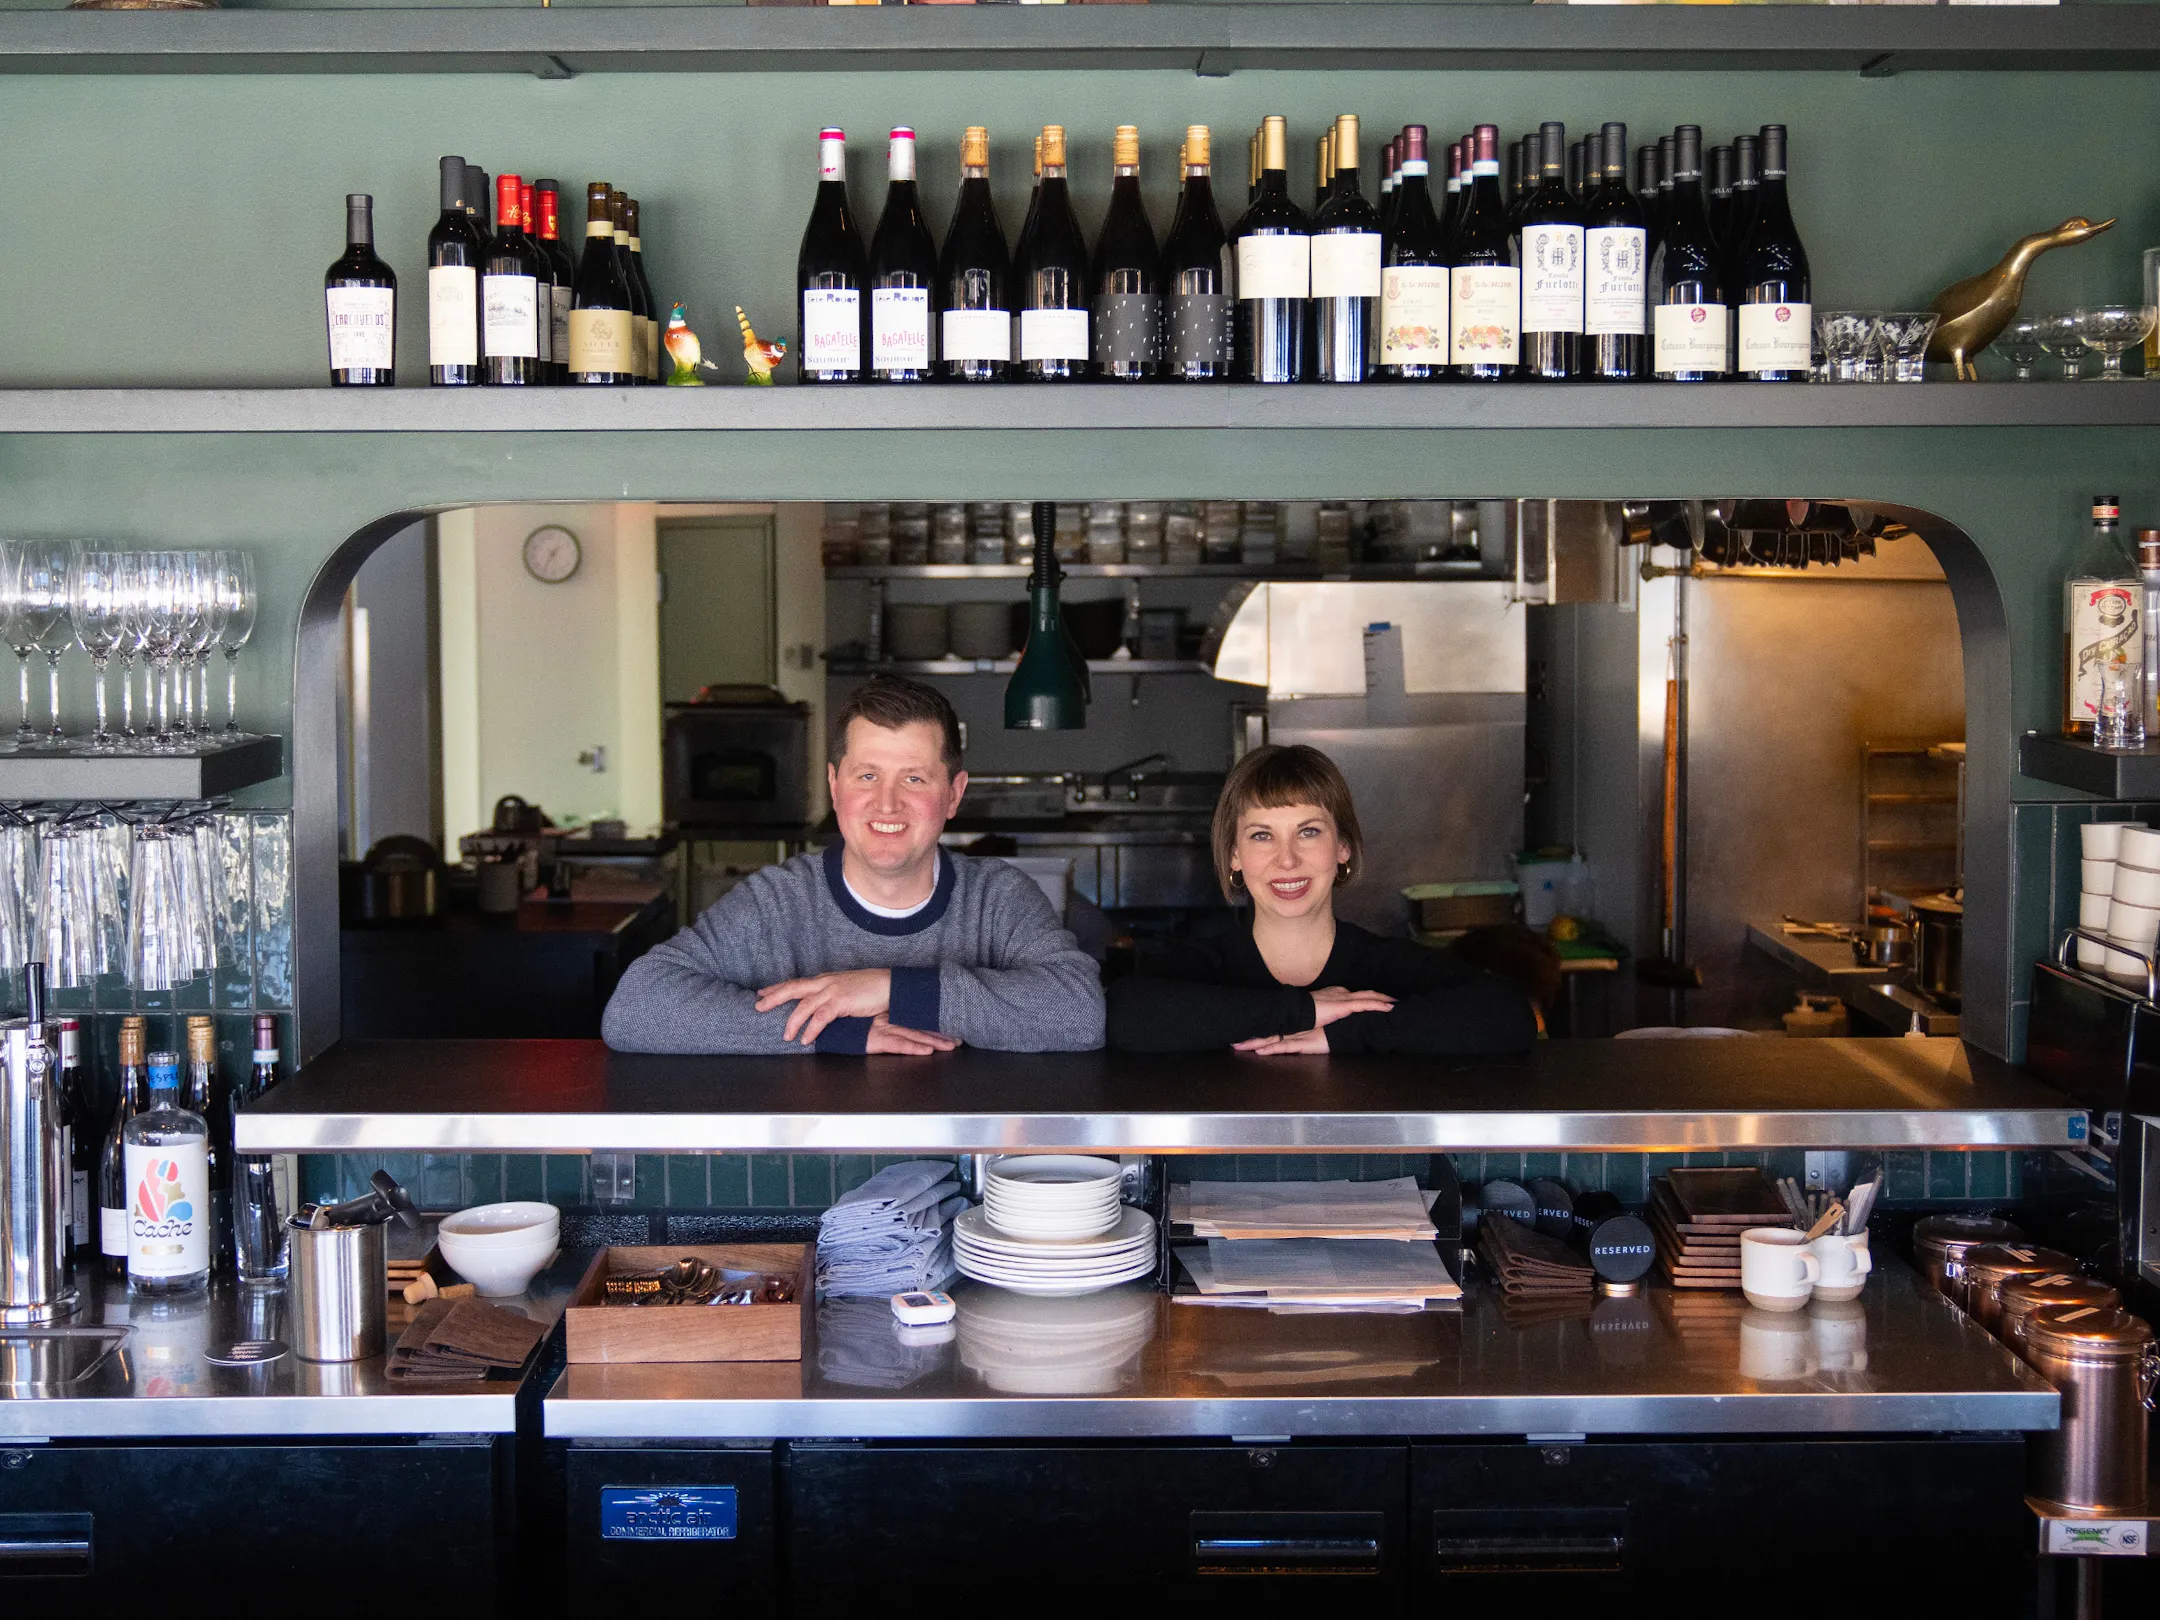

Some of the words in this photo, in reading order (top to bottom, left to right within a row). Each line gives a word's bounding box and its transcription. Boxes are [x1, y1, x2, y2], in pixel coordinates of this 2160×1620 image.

[814, 331, 858, 348] BAGATELLE
[881, 330, 925, 347] BAGATELLE
[2082, 646, 2097, 660] Dry
[133, 1219, 193, 1238] Cache
[1594, 1245, 1651, 1255] RESERVED
[626, 1508, 681, 1525] arctic
[686, 1508, 712, 1525] air
[610, 1526, 667, 1536] COMMERCIAL
[668, 1526, 730, 1536] REFRIGERATOR
[2122, 1534, 2137, 1545] NSF
